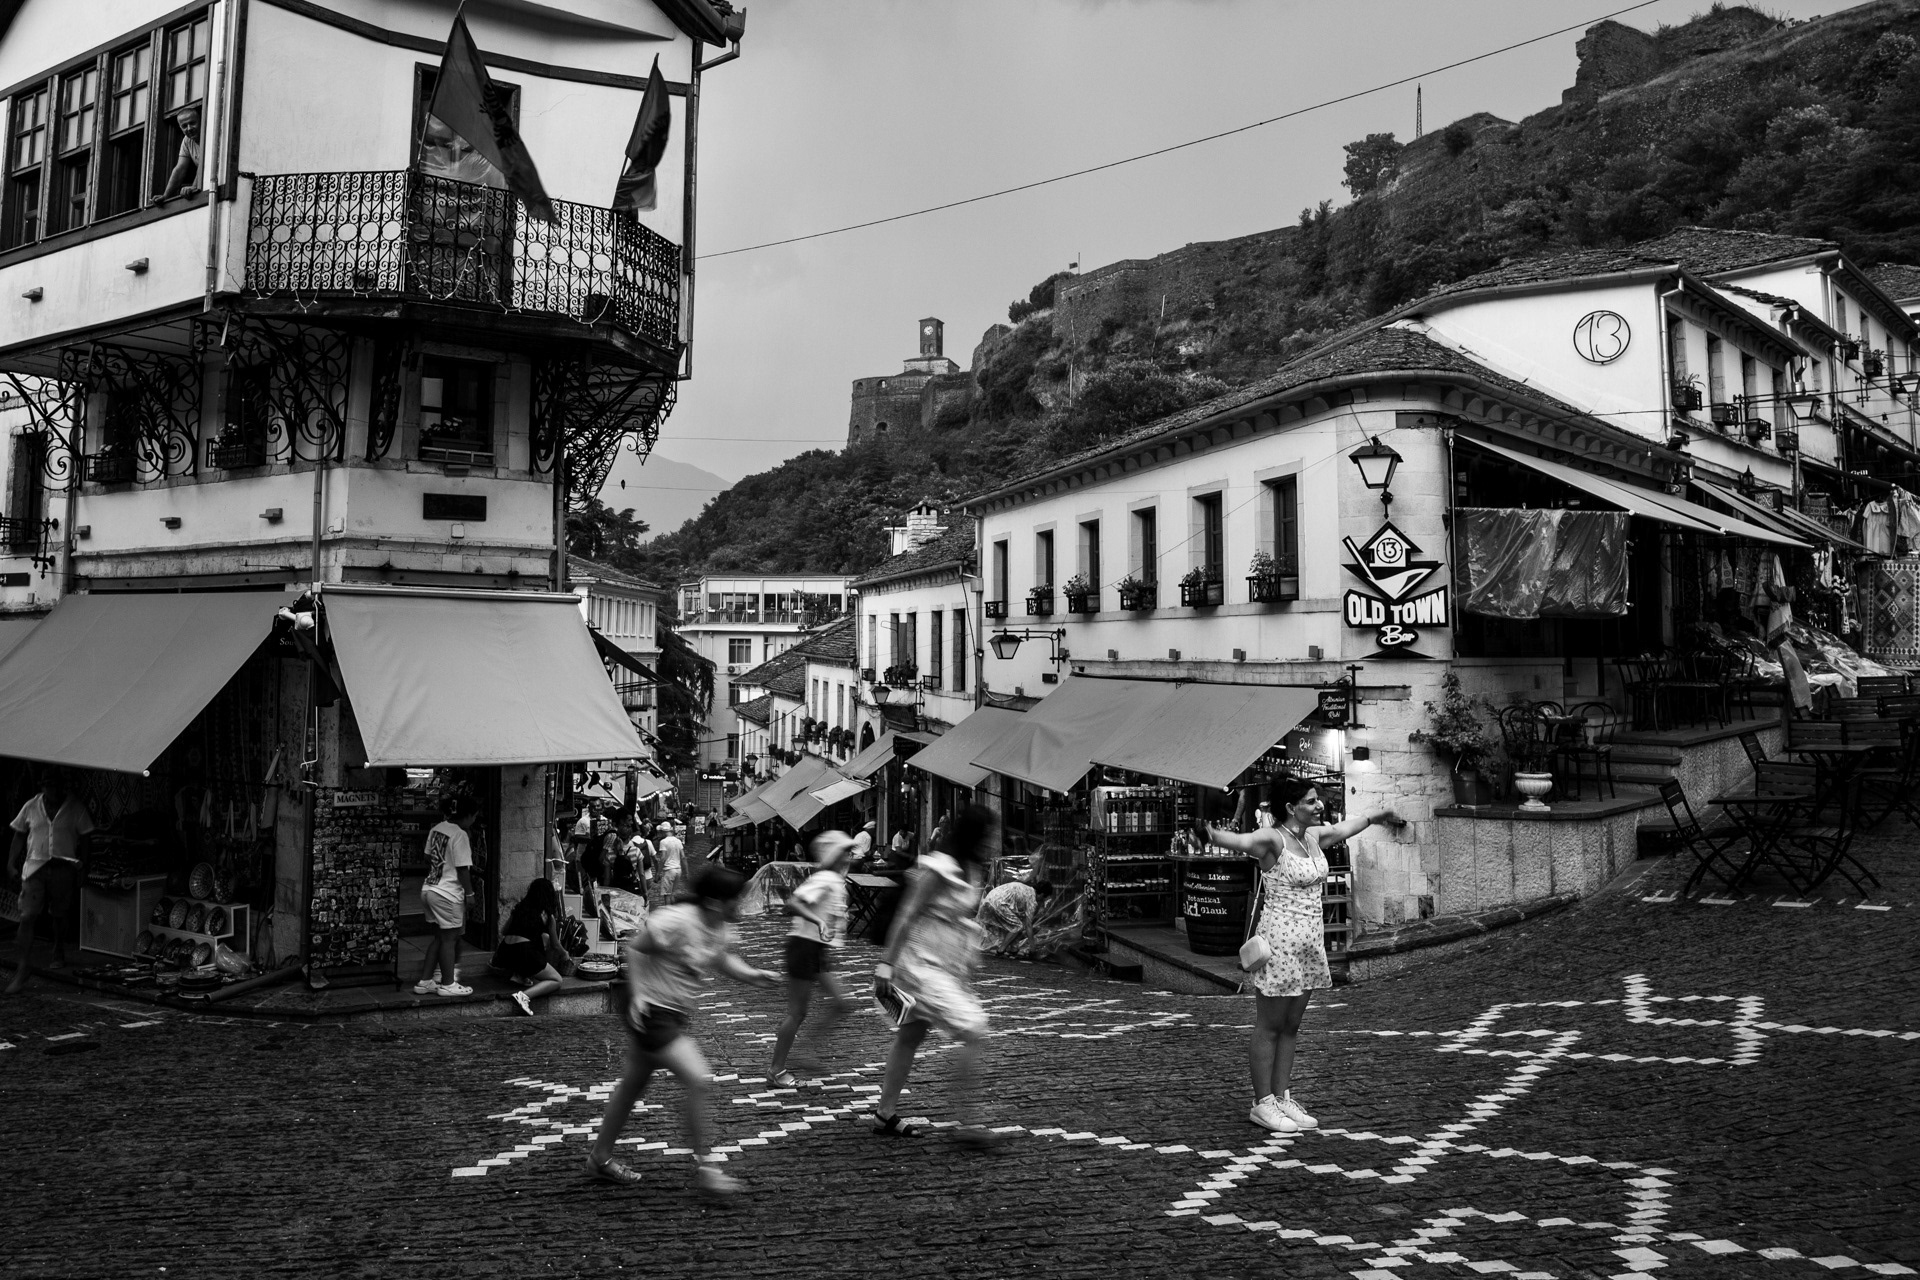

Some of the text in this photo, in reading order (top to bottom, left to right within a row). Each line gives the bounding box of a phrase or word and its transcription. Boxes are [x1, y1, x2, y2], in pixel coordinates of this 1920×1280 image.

[1578, 313, 1622, 361] 13
[1347, 589, 1446, 625] OLD TOWN
[279, 637, 294, 646] Sou
[1380, 625, 1415, 645] Bar
[1299, 737, 1314, 752] Raki
[336, 793, 376, 803] MAGNETS
[1208, 873, 1231, 881] Liker
[1187, 894, 1221, 904] Botanikal
[1182, 900, 1201, 917] aki
